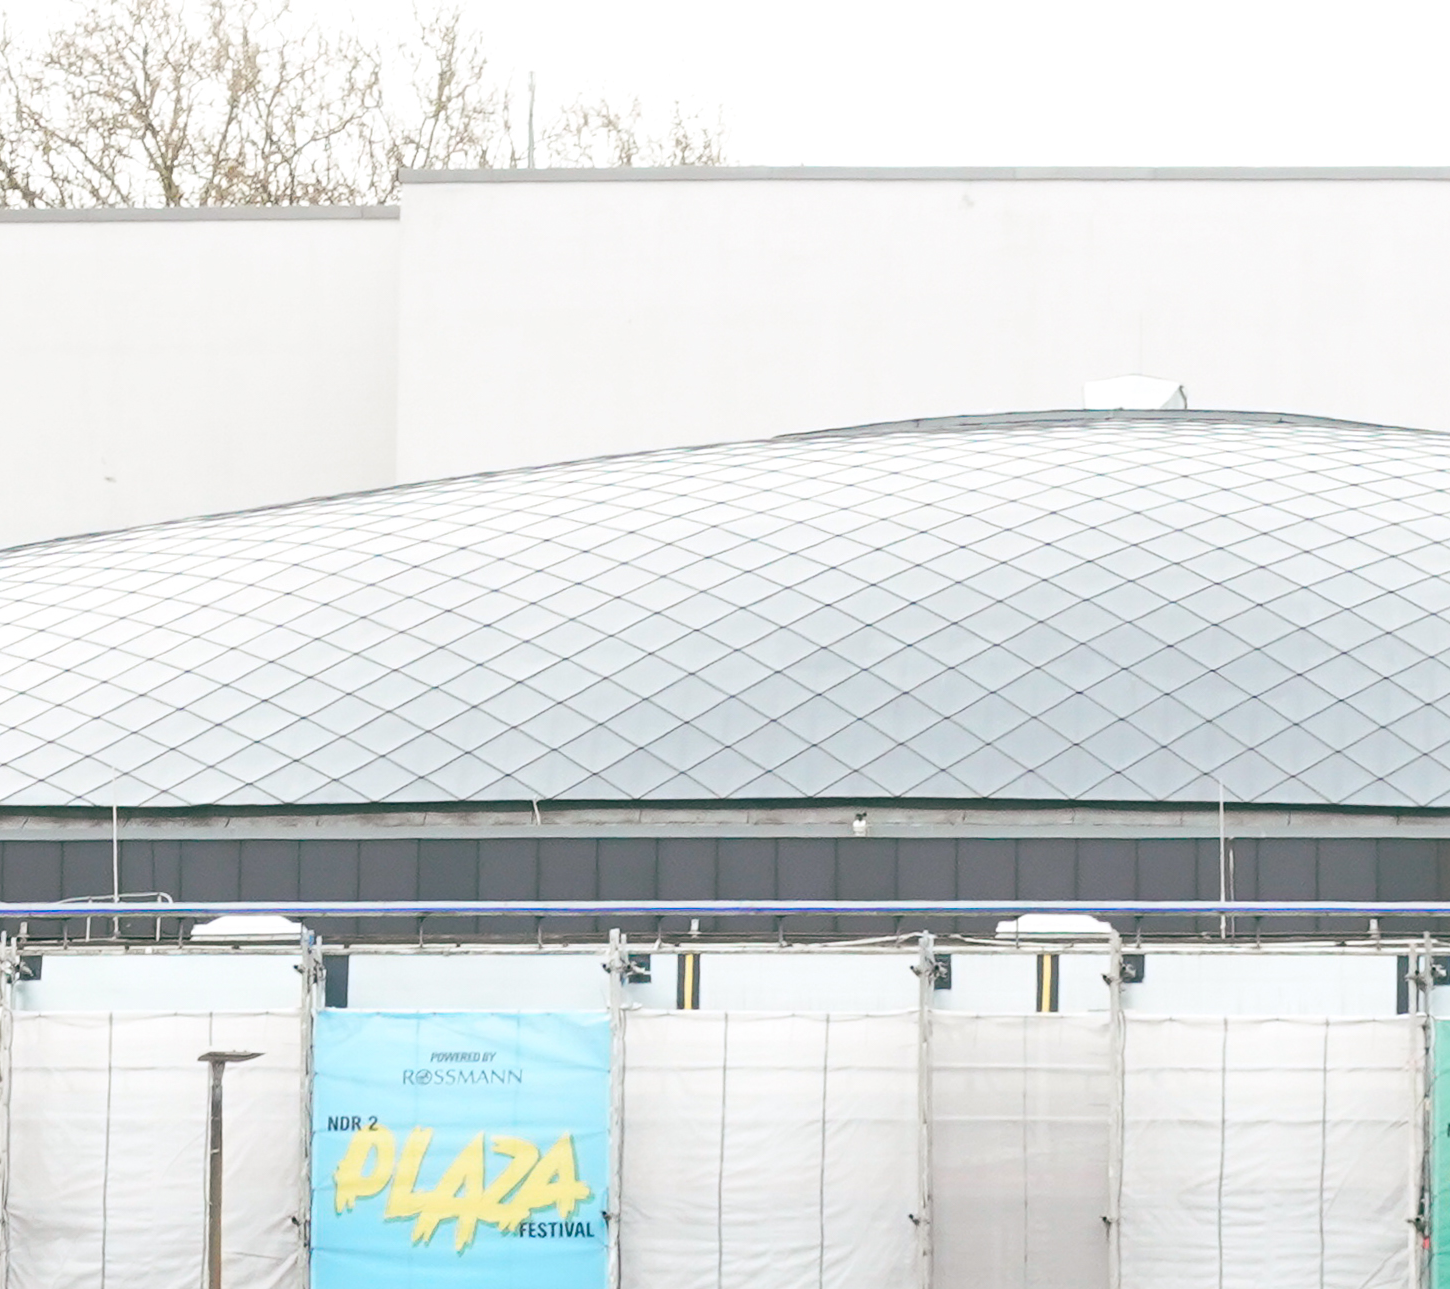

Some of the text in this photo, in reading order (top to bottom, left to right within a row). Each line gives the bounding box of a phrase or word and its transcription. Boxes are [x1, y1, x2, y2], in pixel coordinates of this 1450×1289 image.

[430, 1051, 496, 1063] POWERED BY
[403, 1069, 523, 1085] ROSSMANN
[328, 1116, 378, 1131] NDR 2
[335, 1125, 593, 1254] PLAZA
[519, 1222, 594, 1239] FESTIVAL
